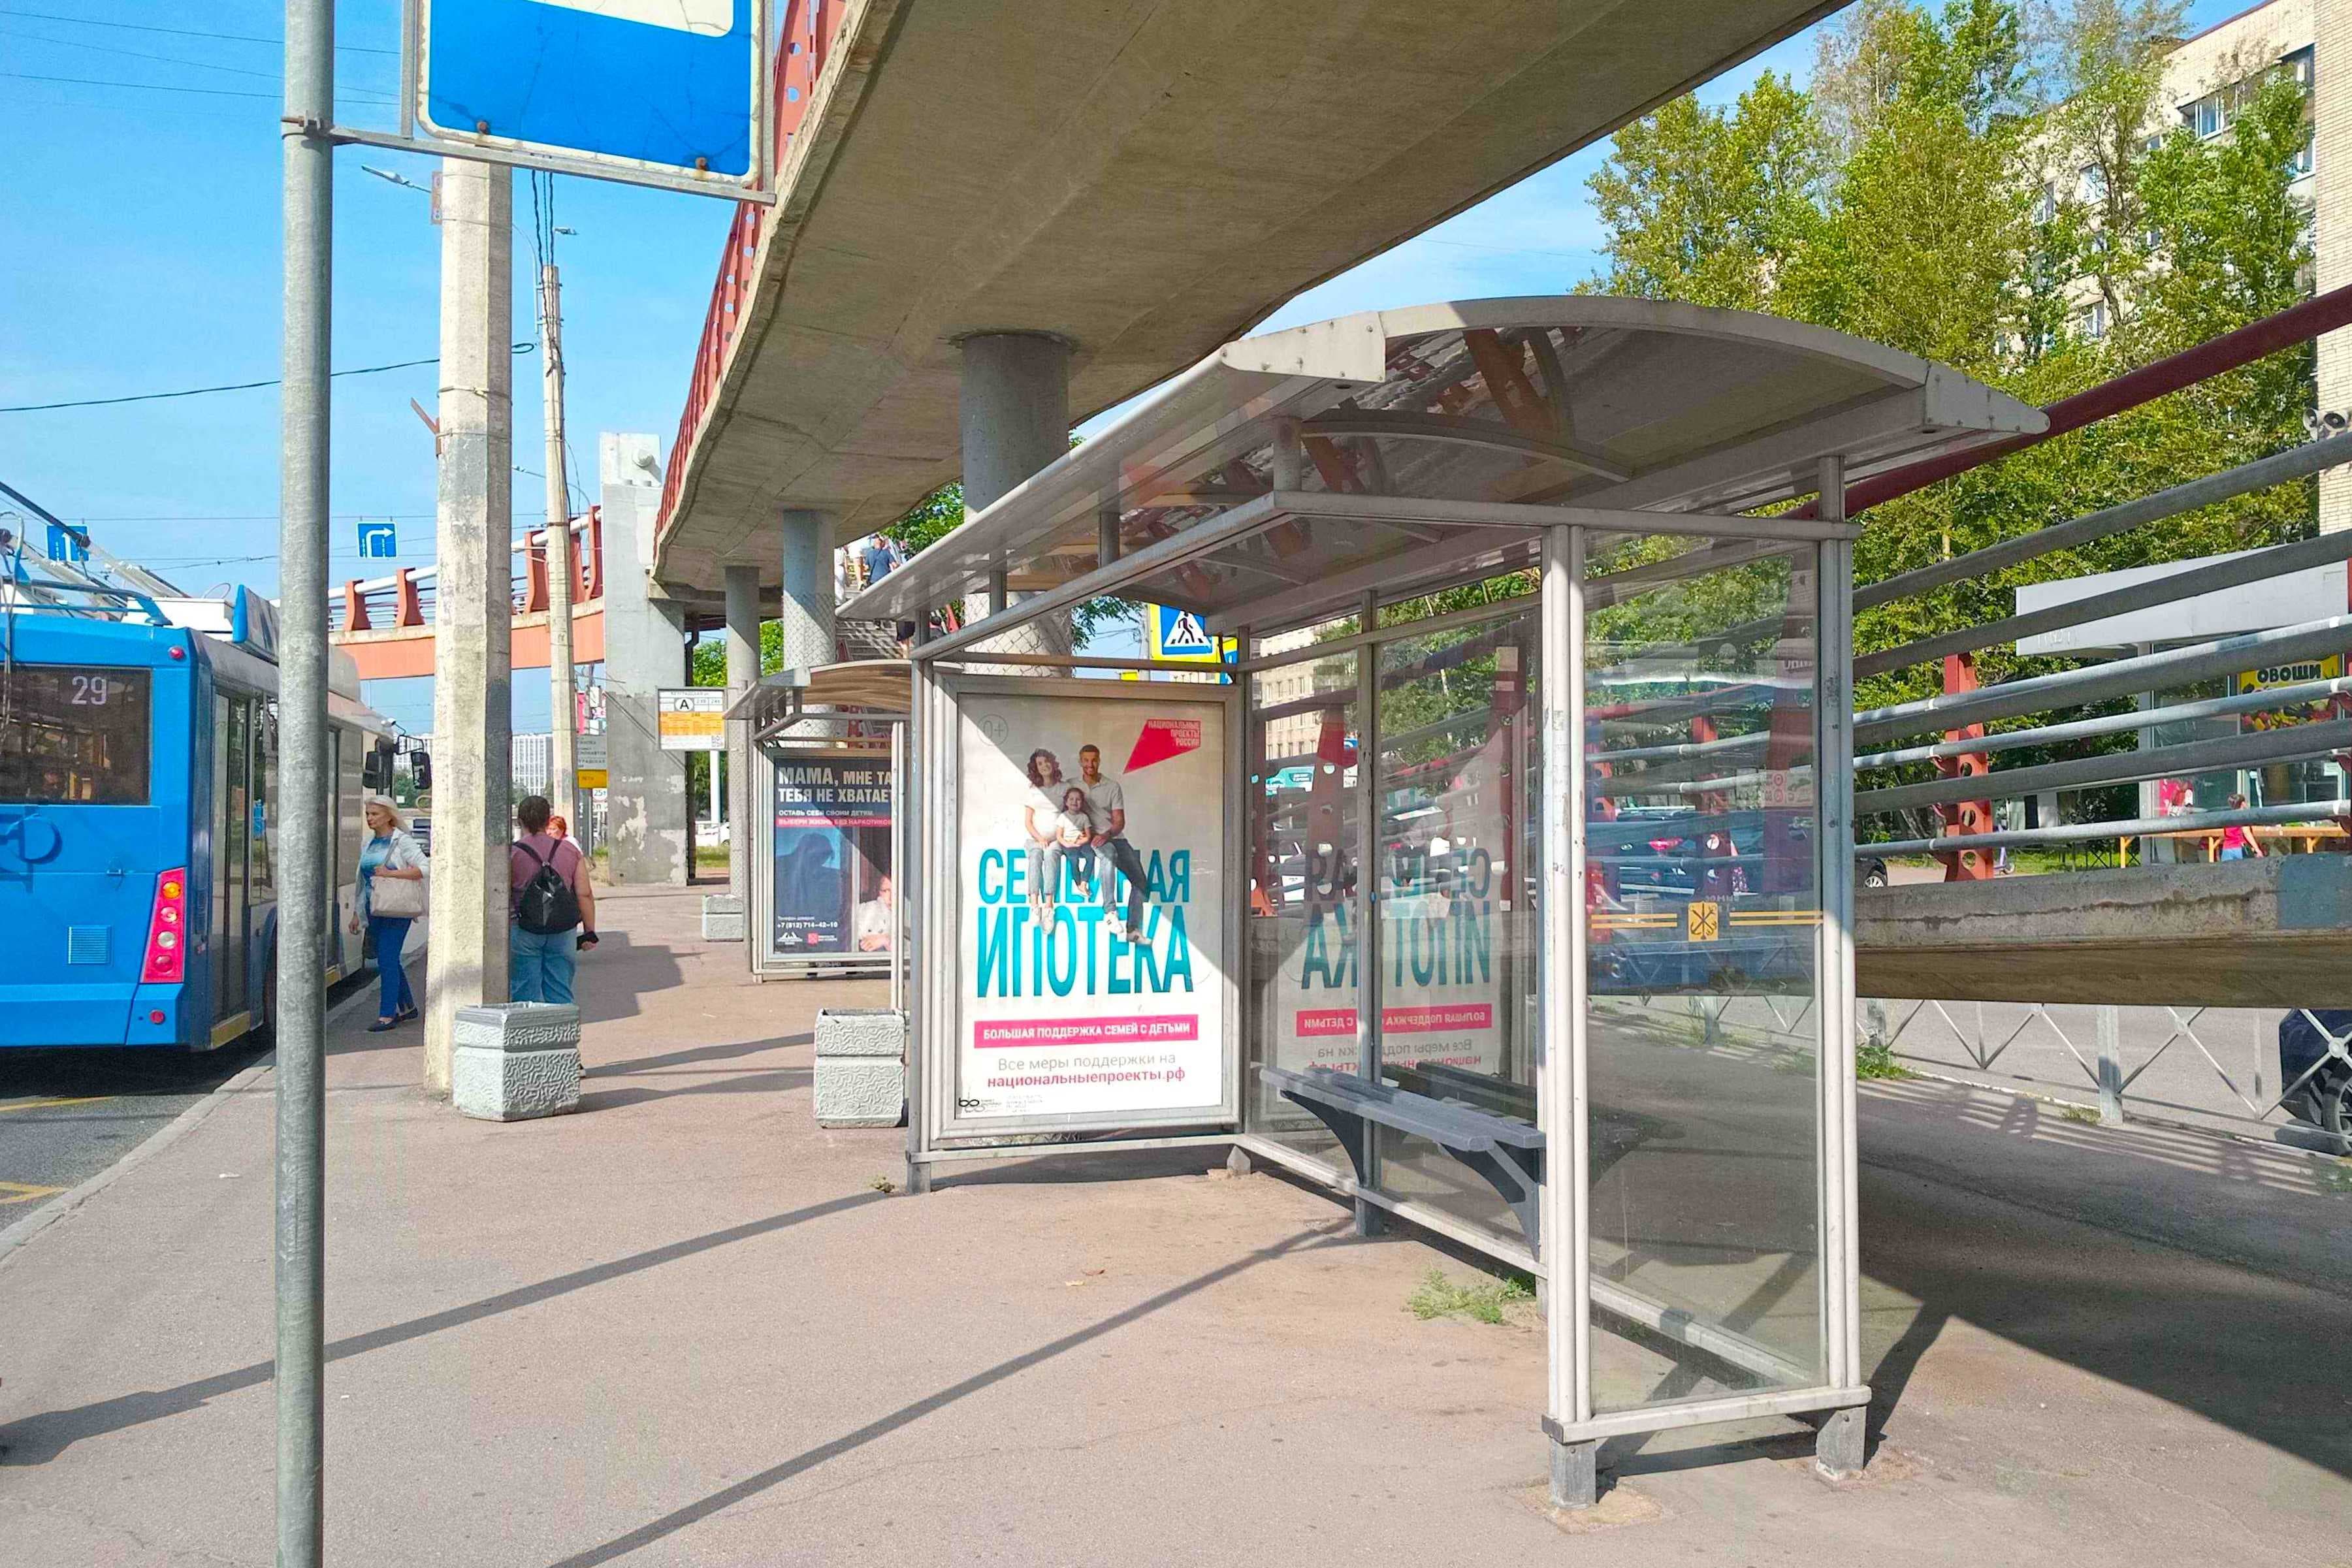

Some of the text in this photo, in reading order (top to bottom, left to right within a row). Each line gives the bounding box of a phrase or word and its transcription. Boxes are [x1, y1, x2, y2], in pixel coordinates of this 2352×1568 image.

[72, 676, 106, 705] 29
[679, 699, 690, 710] А
[983, 720, 1005, 739] 0+
[1148, 720, 1200, 729] НАЦИОНАЛЬНЫЕ
[1170, 729, 1200, 737] ПРОЕКТЫ
[1176, 738, 1200, 747] РОССИИ
[779, 767, 892, 786] МАМА, МНЕ ТА
[779, 788, 812, 803] ТЕБЯ
[817, 789, 833, 803] НЕ
[977, 905, 1194, 998] ИПОТЕКА
[984, 1022, 1190, 1040] БОЛЬШАЯ ПОДДЕРЖКА СЕМЕЙ С ДЕТЬМИ
[998, 1053, 1176, 1071] Все меры поддержки на
[987, 1067, 1186, 1088] национальныепроекты.рф
